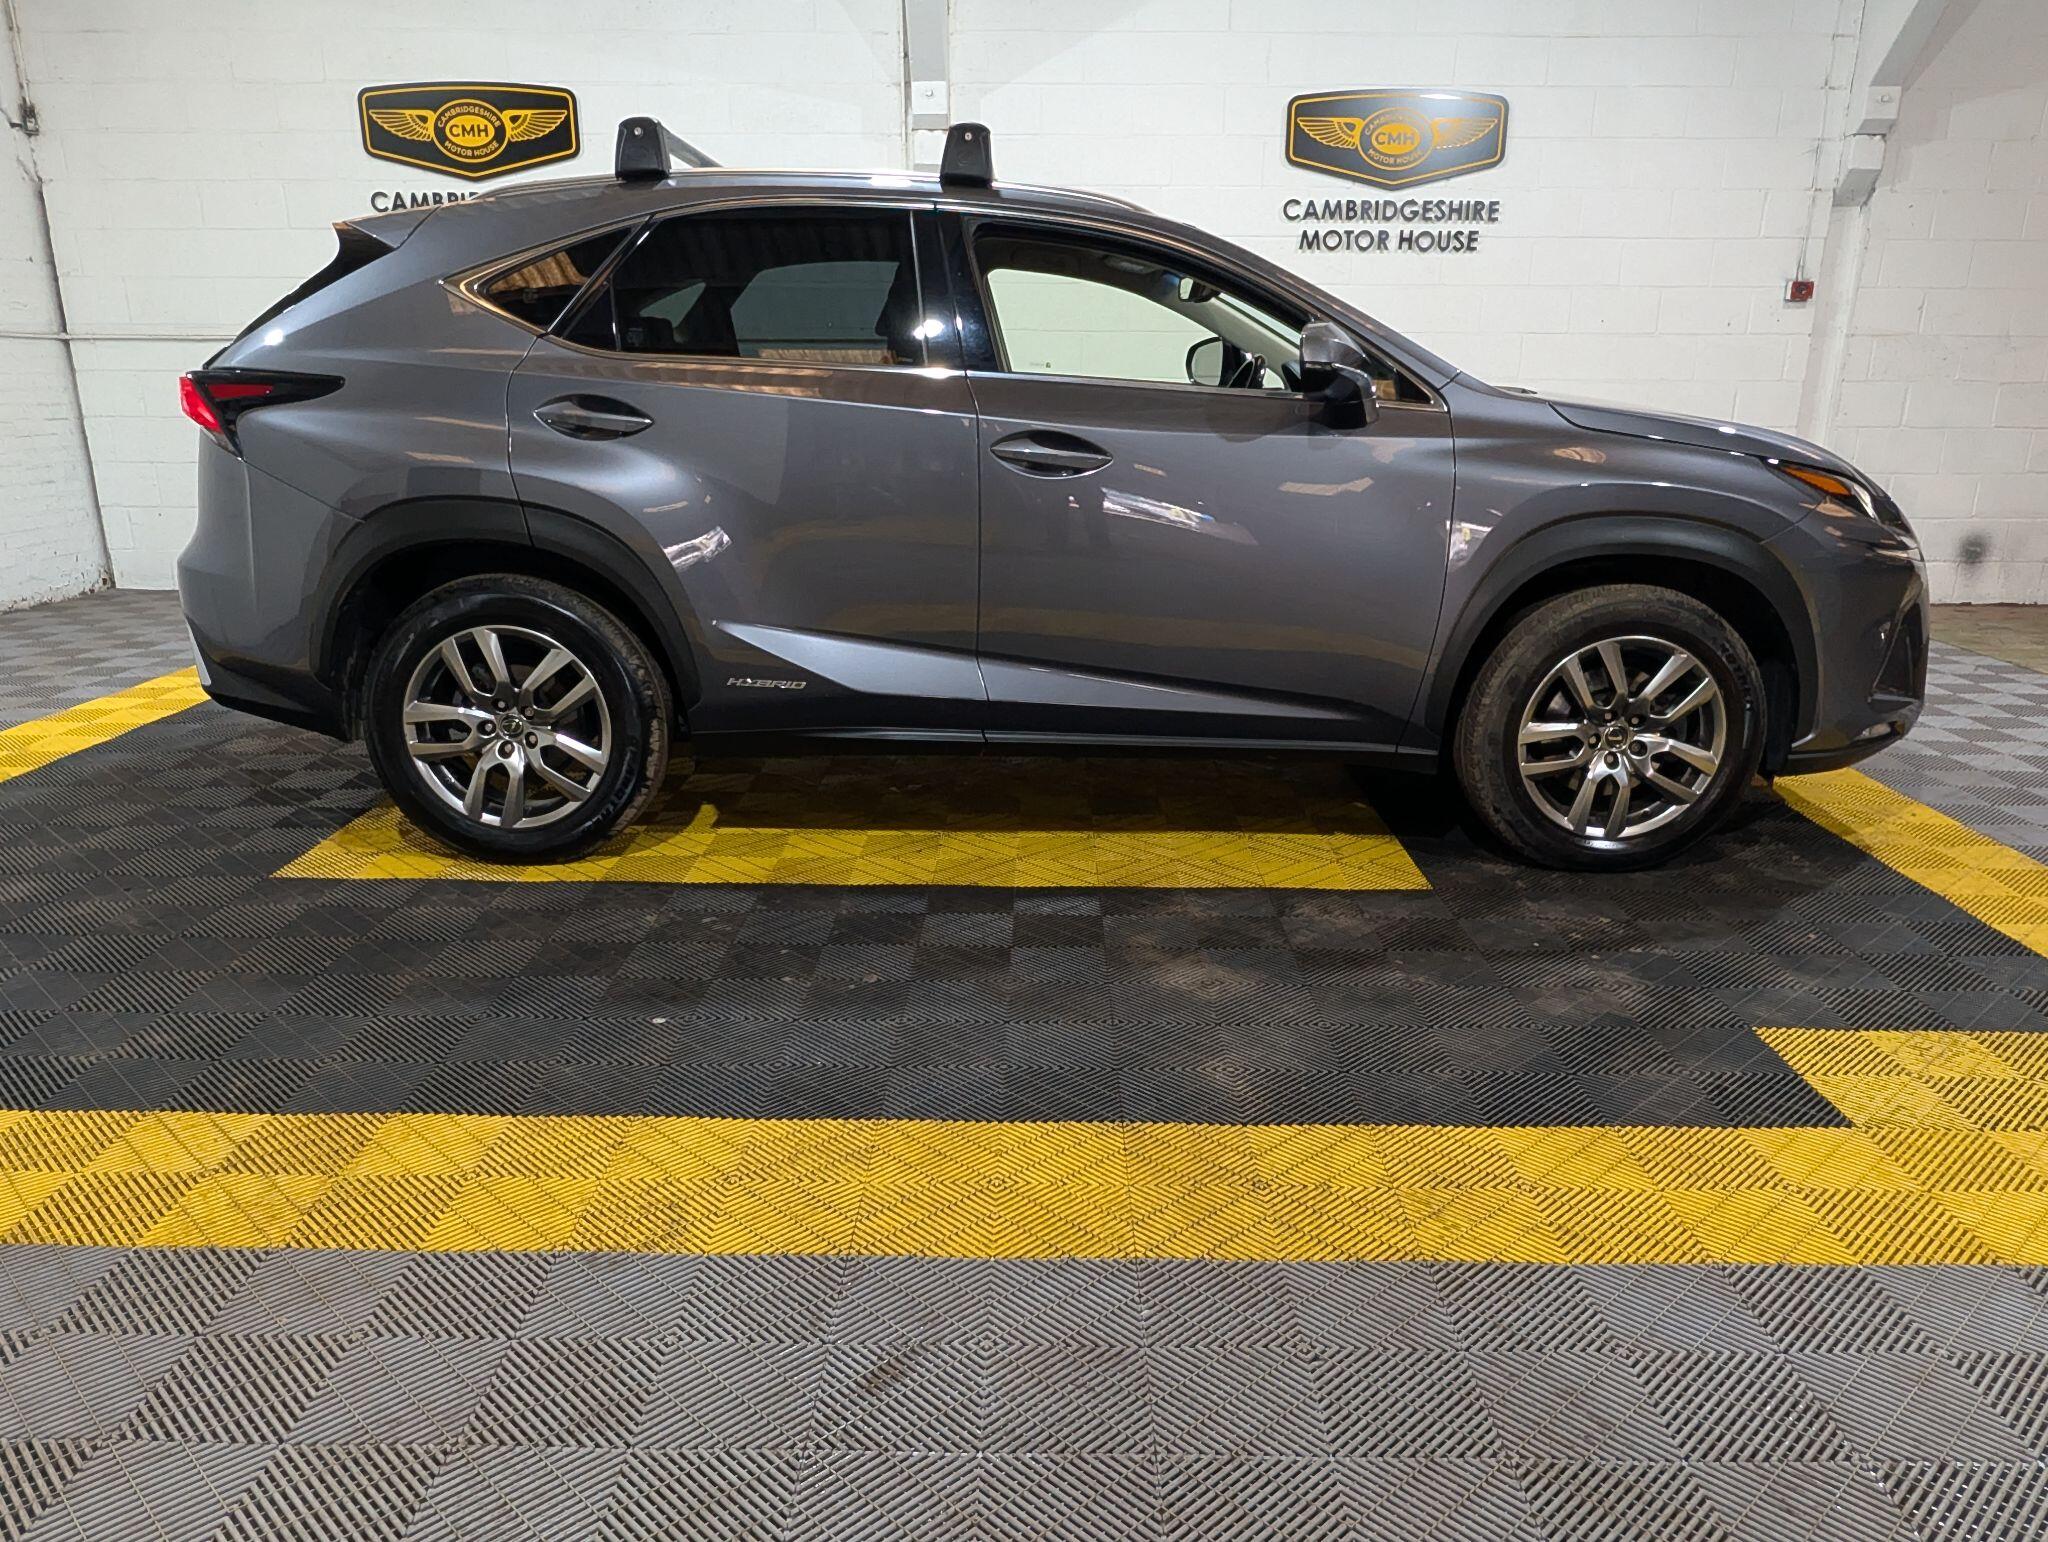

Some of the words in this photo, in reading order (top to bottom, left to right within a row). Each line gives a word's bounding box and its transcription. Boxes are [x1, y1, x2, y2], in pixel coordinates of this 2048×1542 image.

[438, 106, 501, 127] CAMBRIDGESHIRE
[449, 124, 489, 137] CMH
[1374, 132, 1415, 145] CMH
[445, 140, 473, 156] MOTOR
[474, 140, 499, 156] HOUSE
[1367, 148, 1395, 164] MOTOR
[1283, 199, 1500, 221] CAMBRIDGESHIRE
[1299, 229, 1389, 251] MOTOR
[1399, 229, 1479, 252] HOUSE
[726, 677, 807, 689] HYBRID
